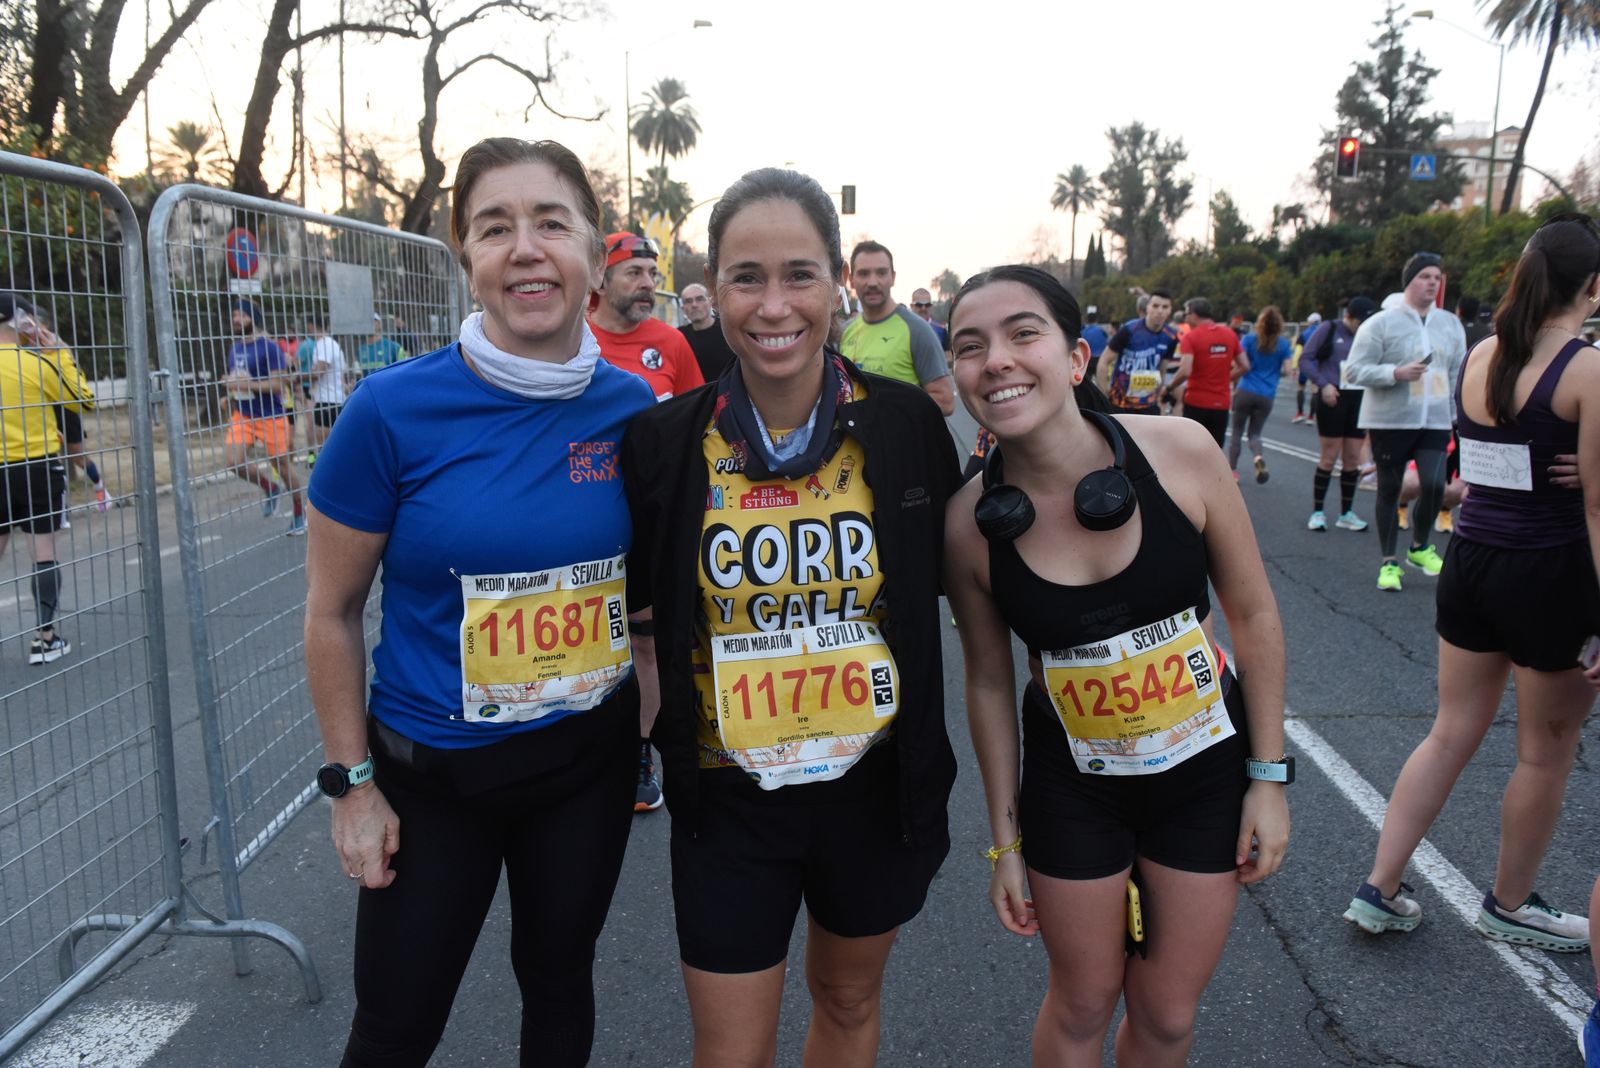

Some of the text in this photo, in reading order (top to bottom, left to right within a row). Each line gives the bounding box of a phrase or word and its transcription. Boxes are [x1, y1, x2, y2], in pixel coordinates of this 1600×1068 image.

[568, 441, 616, 455] FORGET
[569, 469, 607, 483] GYM
[836, 468, 851, 490] POWER
[760, 488, 776, 498] BE
[745, 496, 792, 508] STRONG
[475, 560, 613, 592] MEDIO MARATÓN SEVILLA
[712, 594, 735, 624] Y
[479, 595, 604, 657] 11687
[722, 622, 866, 654] MEDIO MARATÓN SEVILLA
[1074, 642, 1112, 660] MARATÓN
[1131, 617, 1180, 651] SEVILLA
[532, 652, 566, 664] Amanda
[537, 670, 562, 680] Fennell
[732, 660, 869, 720] 11776
[1061, 653, 1194, 717] 12542
[797, 716, 809, 724] Ire
[1123, 714, 1146, 725] Kiara
[777, 733, 805, 744] Gordillo
[1118, 731, 1128, 740] De
[1127, 725, 1161, 738] Cristofaro
[1143, 755, 1168, 767] HOKA
[803, 763, 830, 776] HOKA
